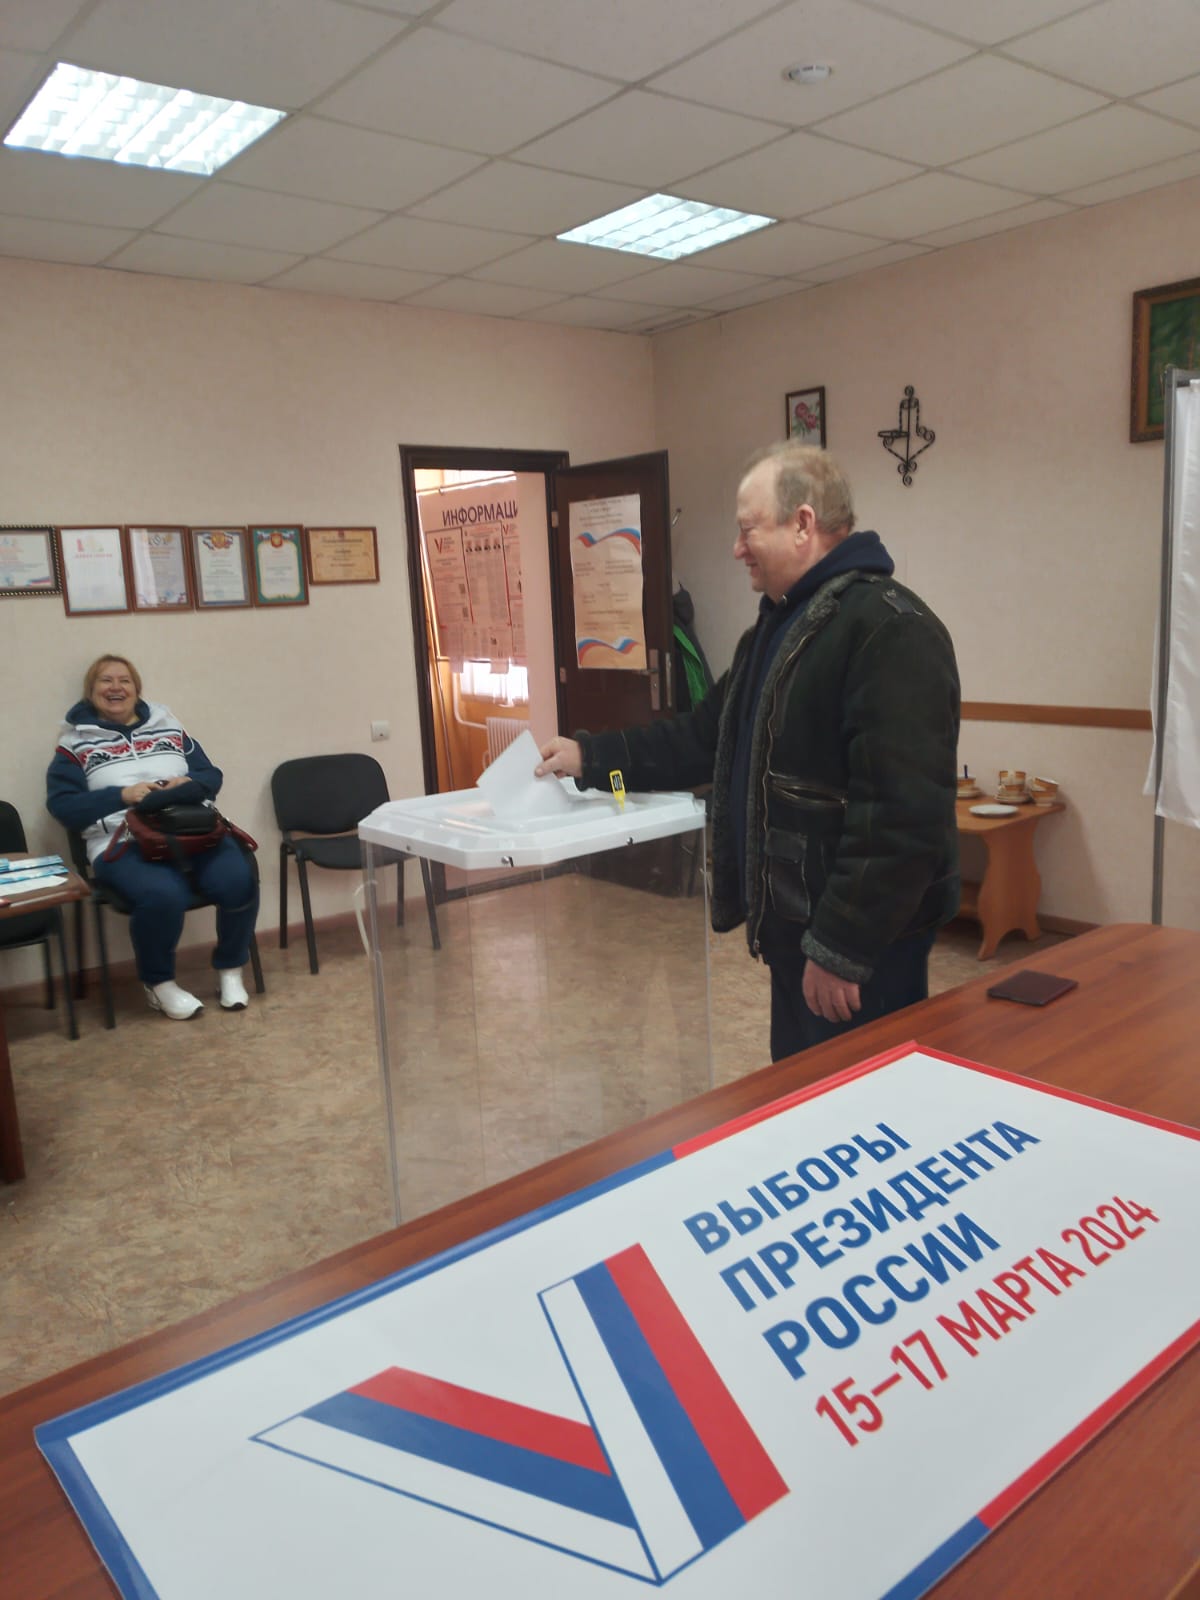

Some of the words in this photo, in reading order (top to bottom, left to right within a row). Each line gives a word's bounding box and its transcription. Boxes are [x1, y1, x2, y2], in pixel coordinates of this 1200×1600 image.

[683, 1122, 912, 1254] ВЫБОРЫ
[719, 1121, 1040, 1312] ПРЕЗИДЕНТА
[763, 1212, 1001, 1380] РОССИИ
[936, 1247, 1086, 1357] МАРТА
[1061, 1196, 1159, 1266] 2024
